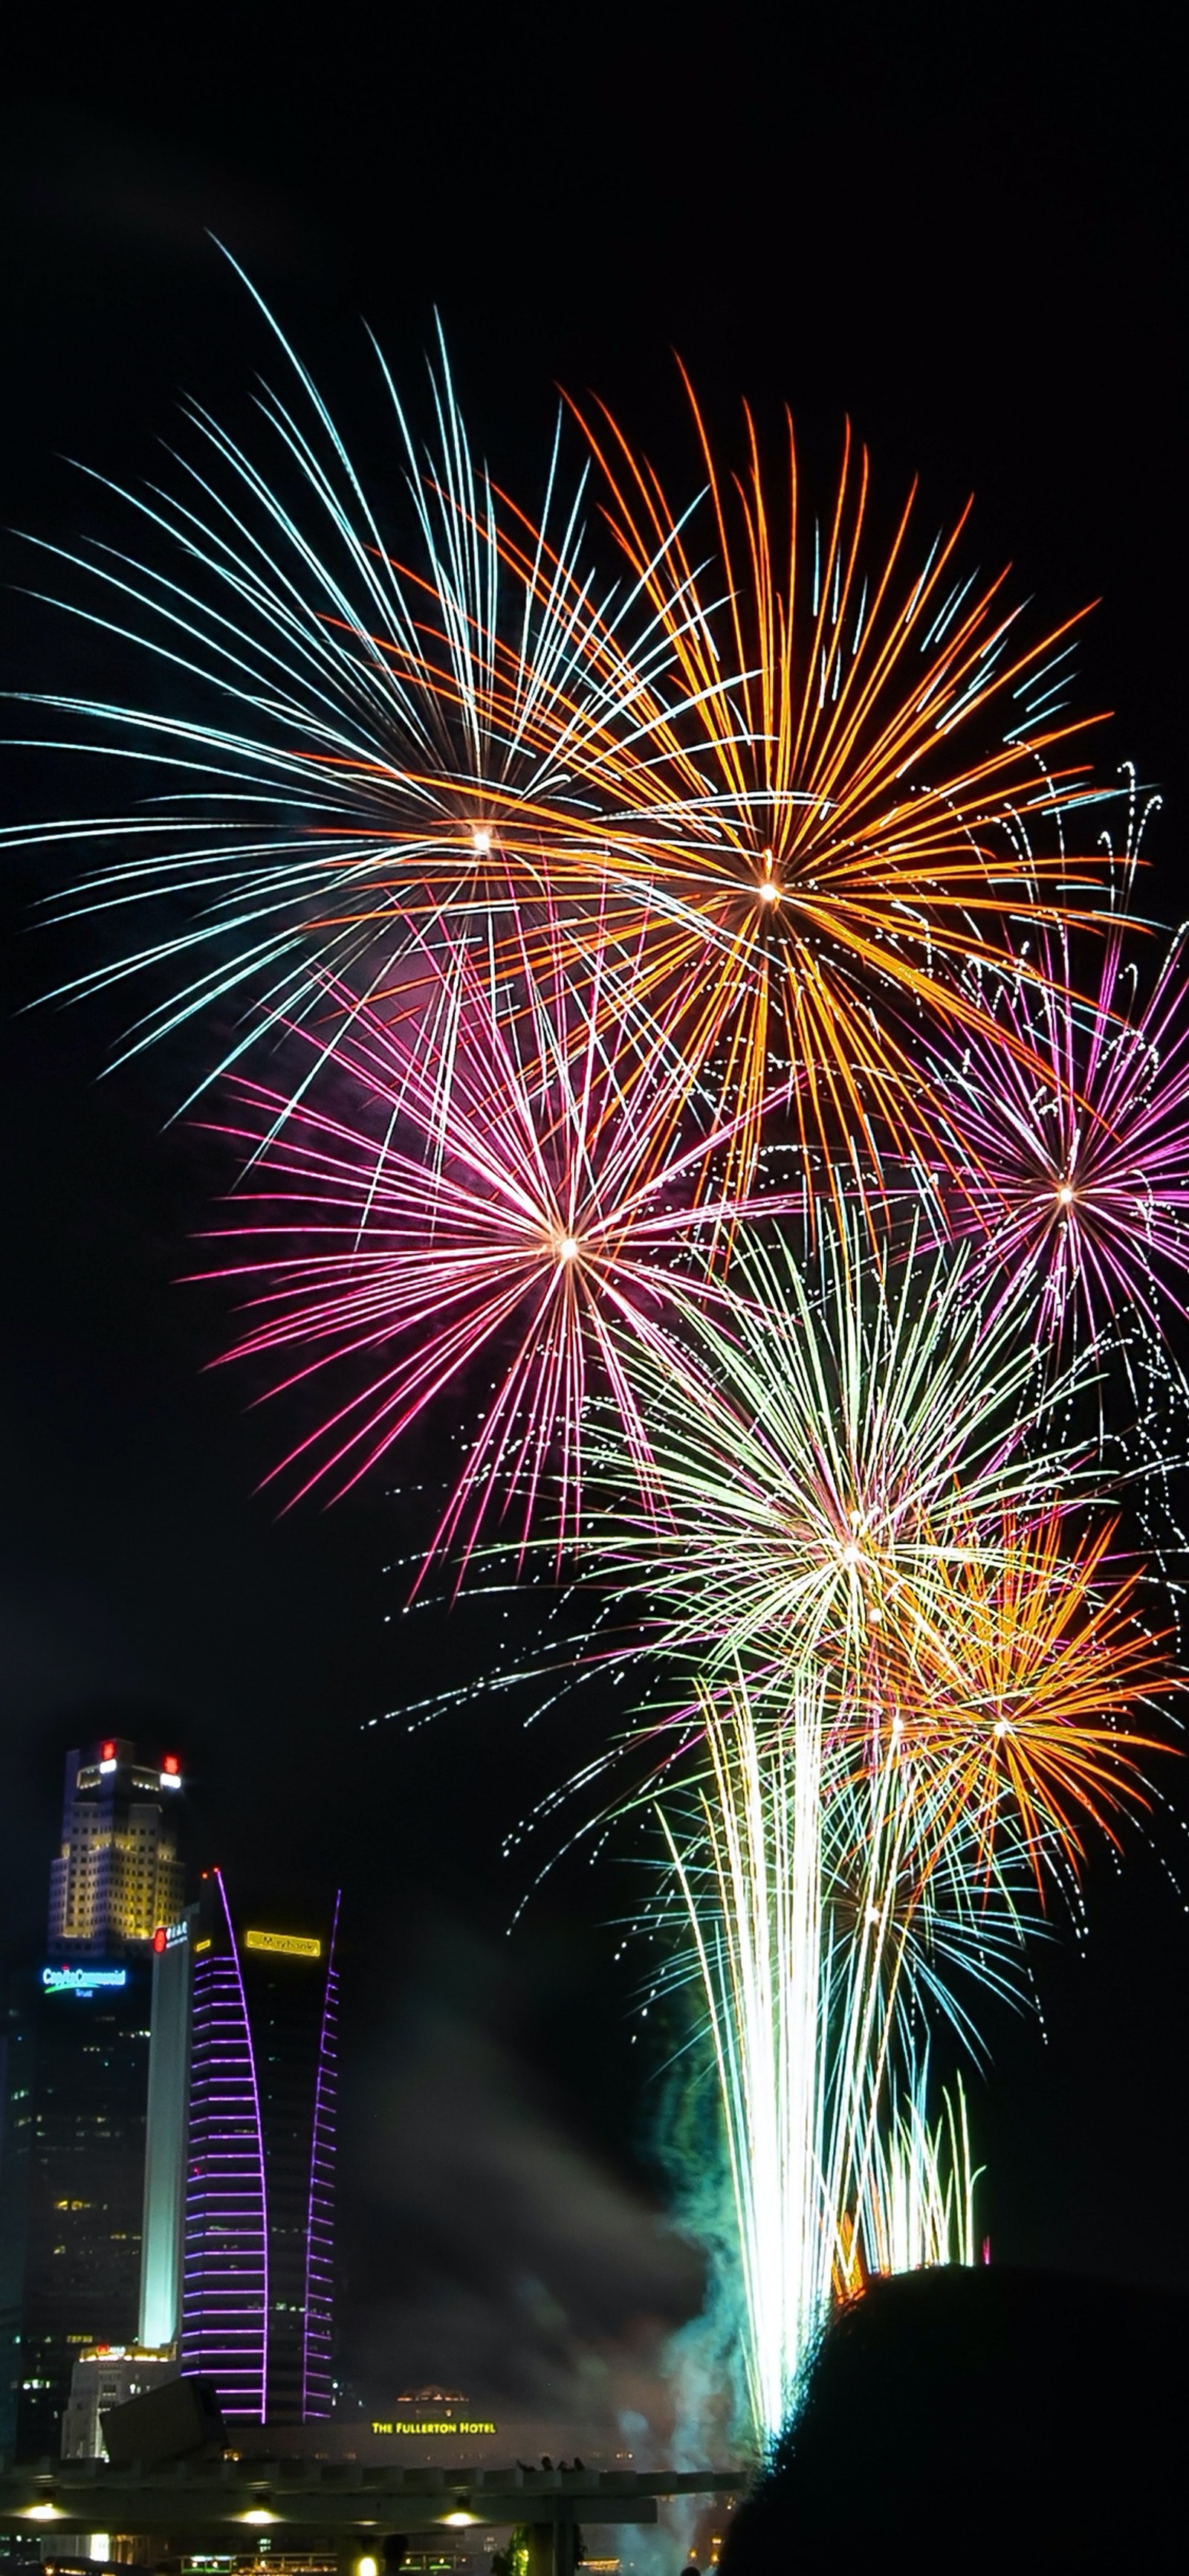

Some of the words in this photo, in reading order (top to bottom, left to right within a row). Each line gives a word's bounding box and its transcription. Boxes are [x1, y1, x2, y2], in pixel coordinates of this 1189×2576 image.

[372, 2422, 392, 2434] THE
[395, 2422, 457, 2434] FULLERTON
[459, 2422, 496, 2434] HOTEL
